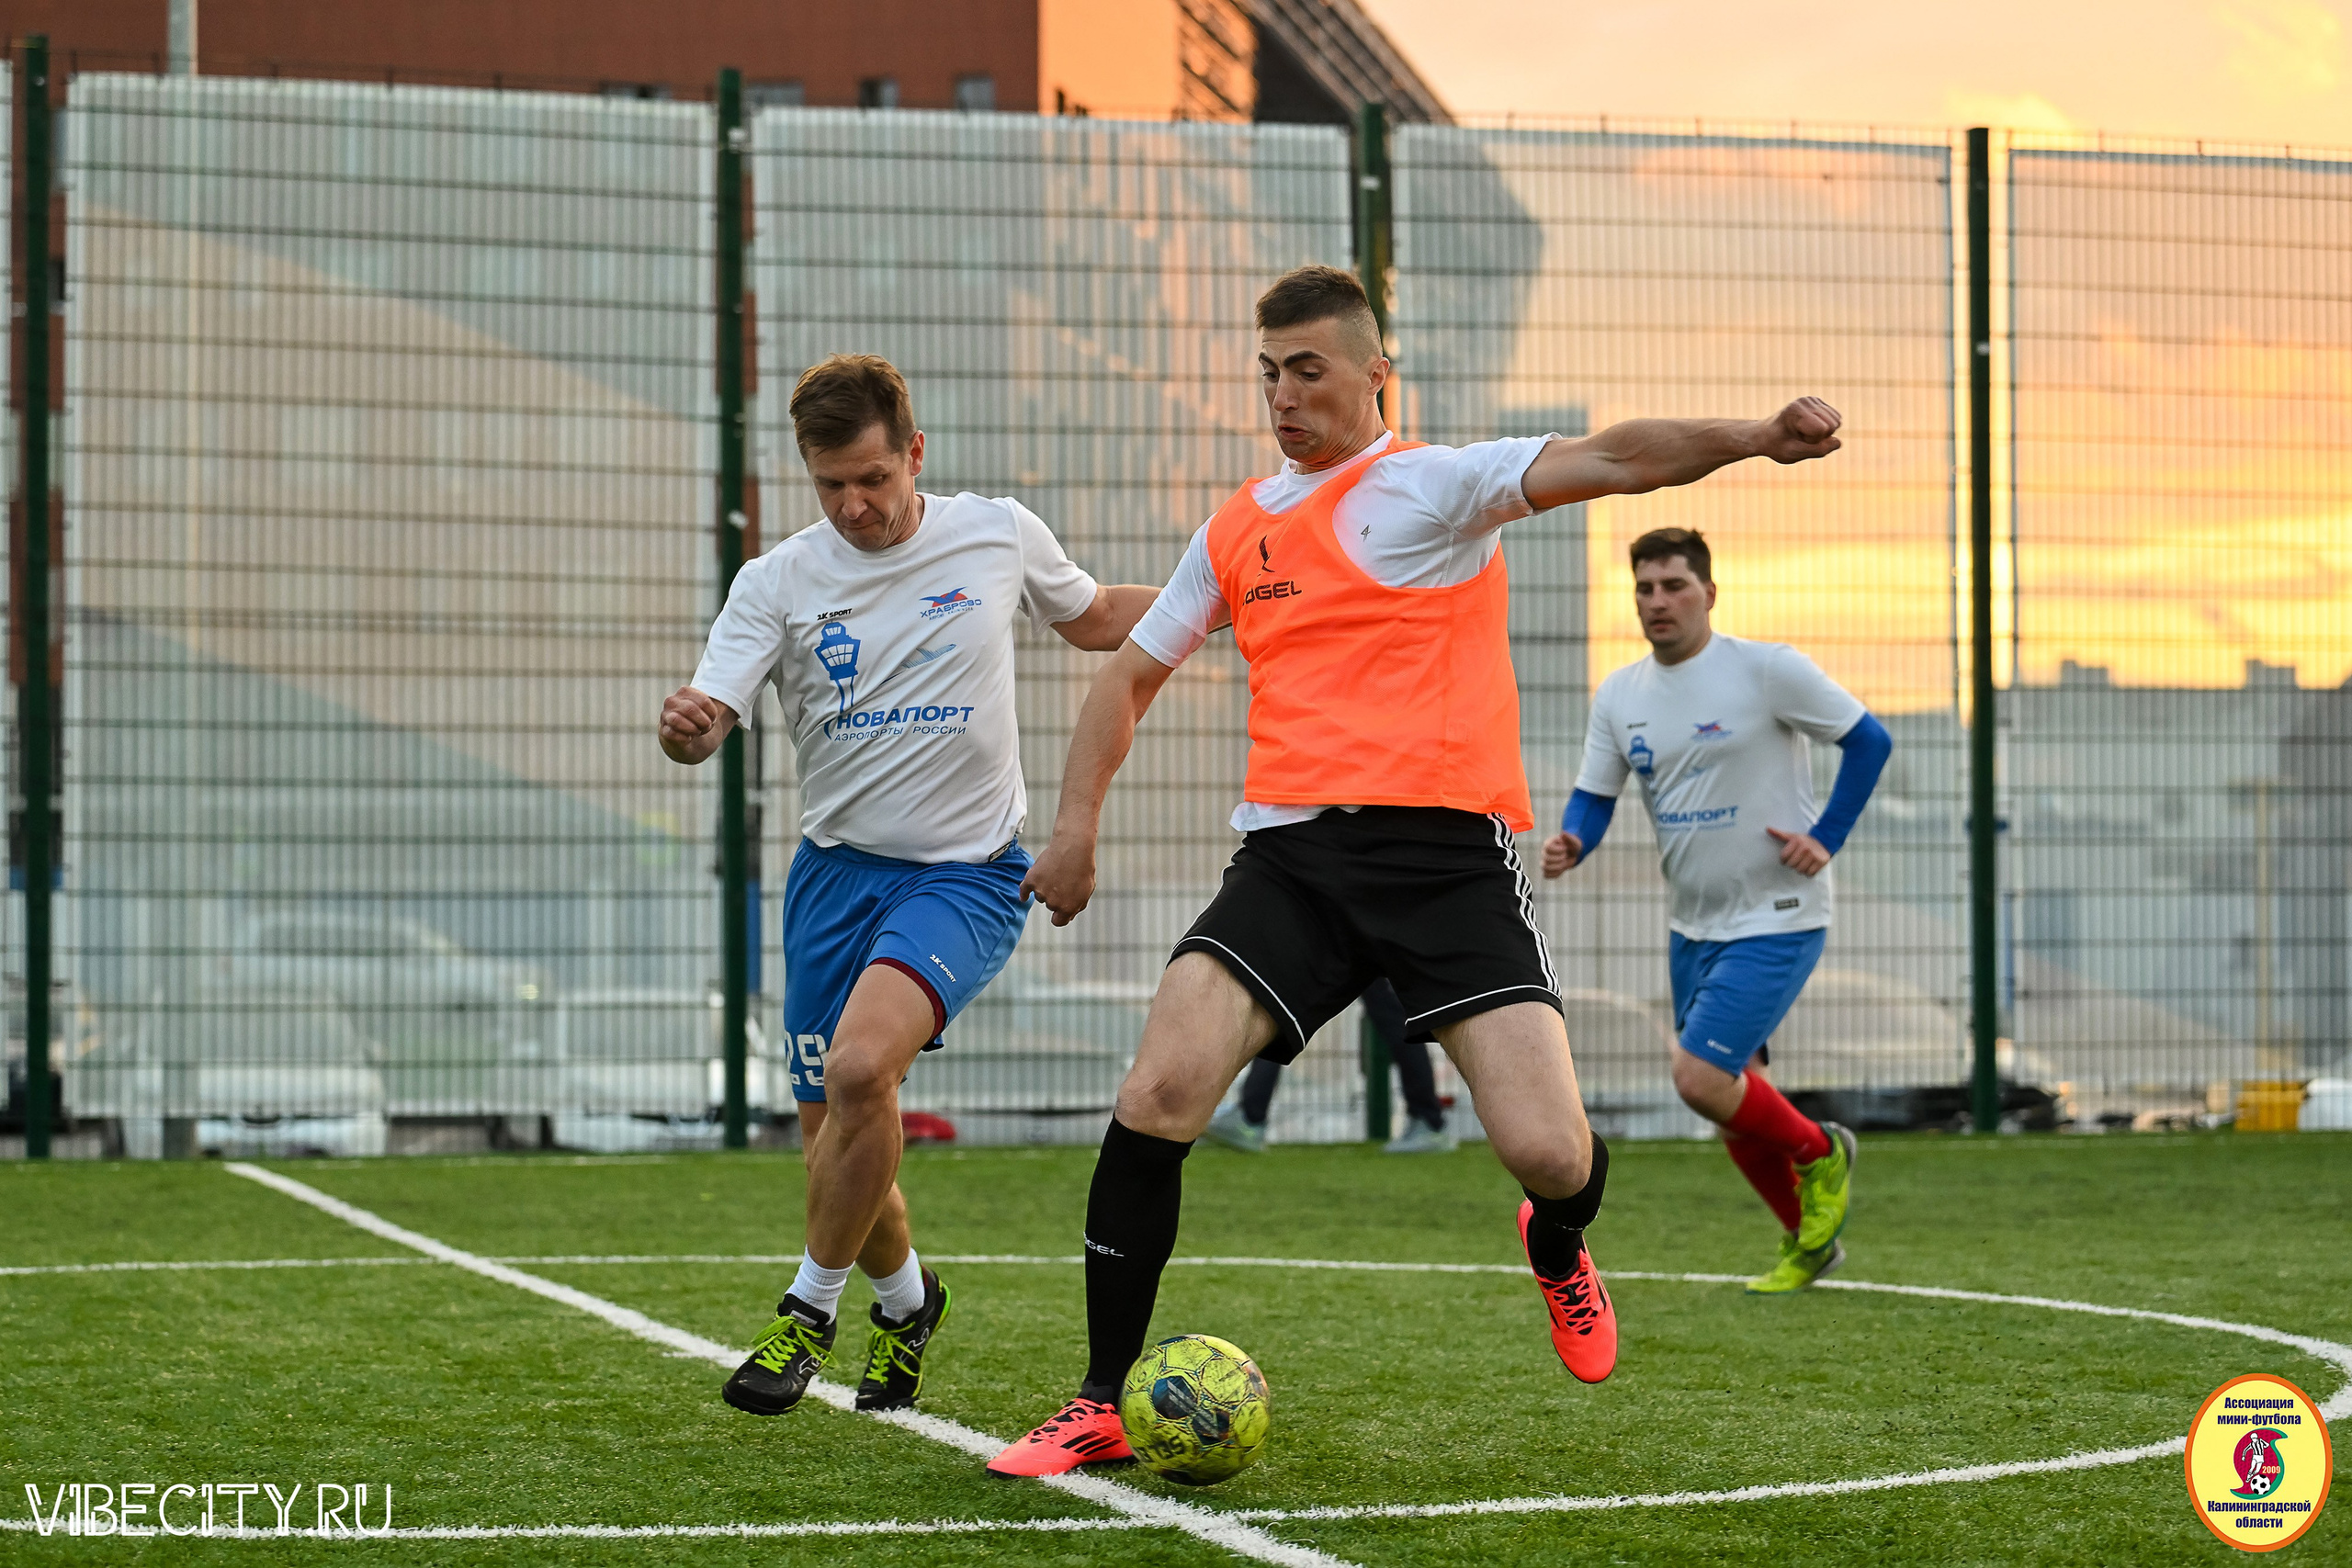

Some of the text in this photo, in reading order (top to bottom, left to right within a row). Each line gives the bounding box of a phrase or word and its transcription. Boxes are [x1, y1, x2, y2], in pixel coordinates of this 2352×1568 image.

[1243, 581, 1302, 606] OGEL
[829, 608, 853, 618] SPORT
[920, 599, 982, 618] ХРАБРОВО
[836, 705, 974, 729] НОВАПОРТ
[834, 726, 967, 741] АЭРОПОРТЫ РОССИИ
[939, 964, 956, 983] SPORT
